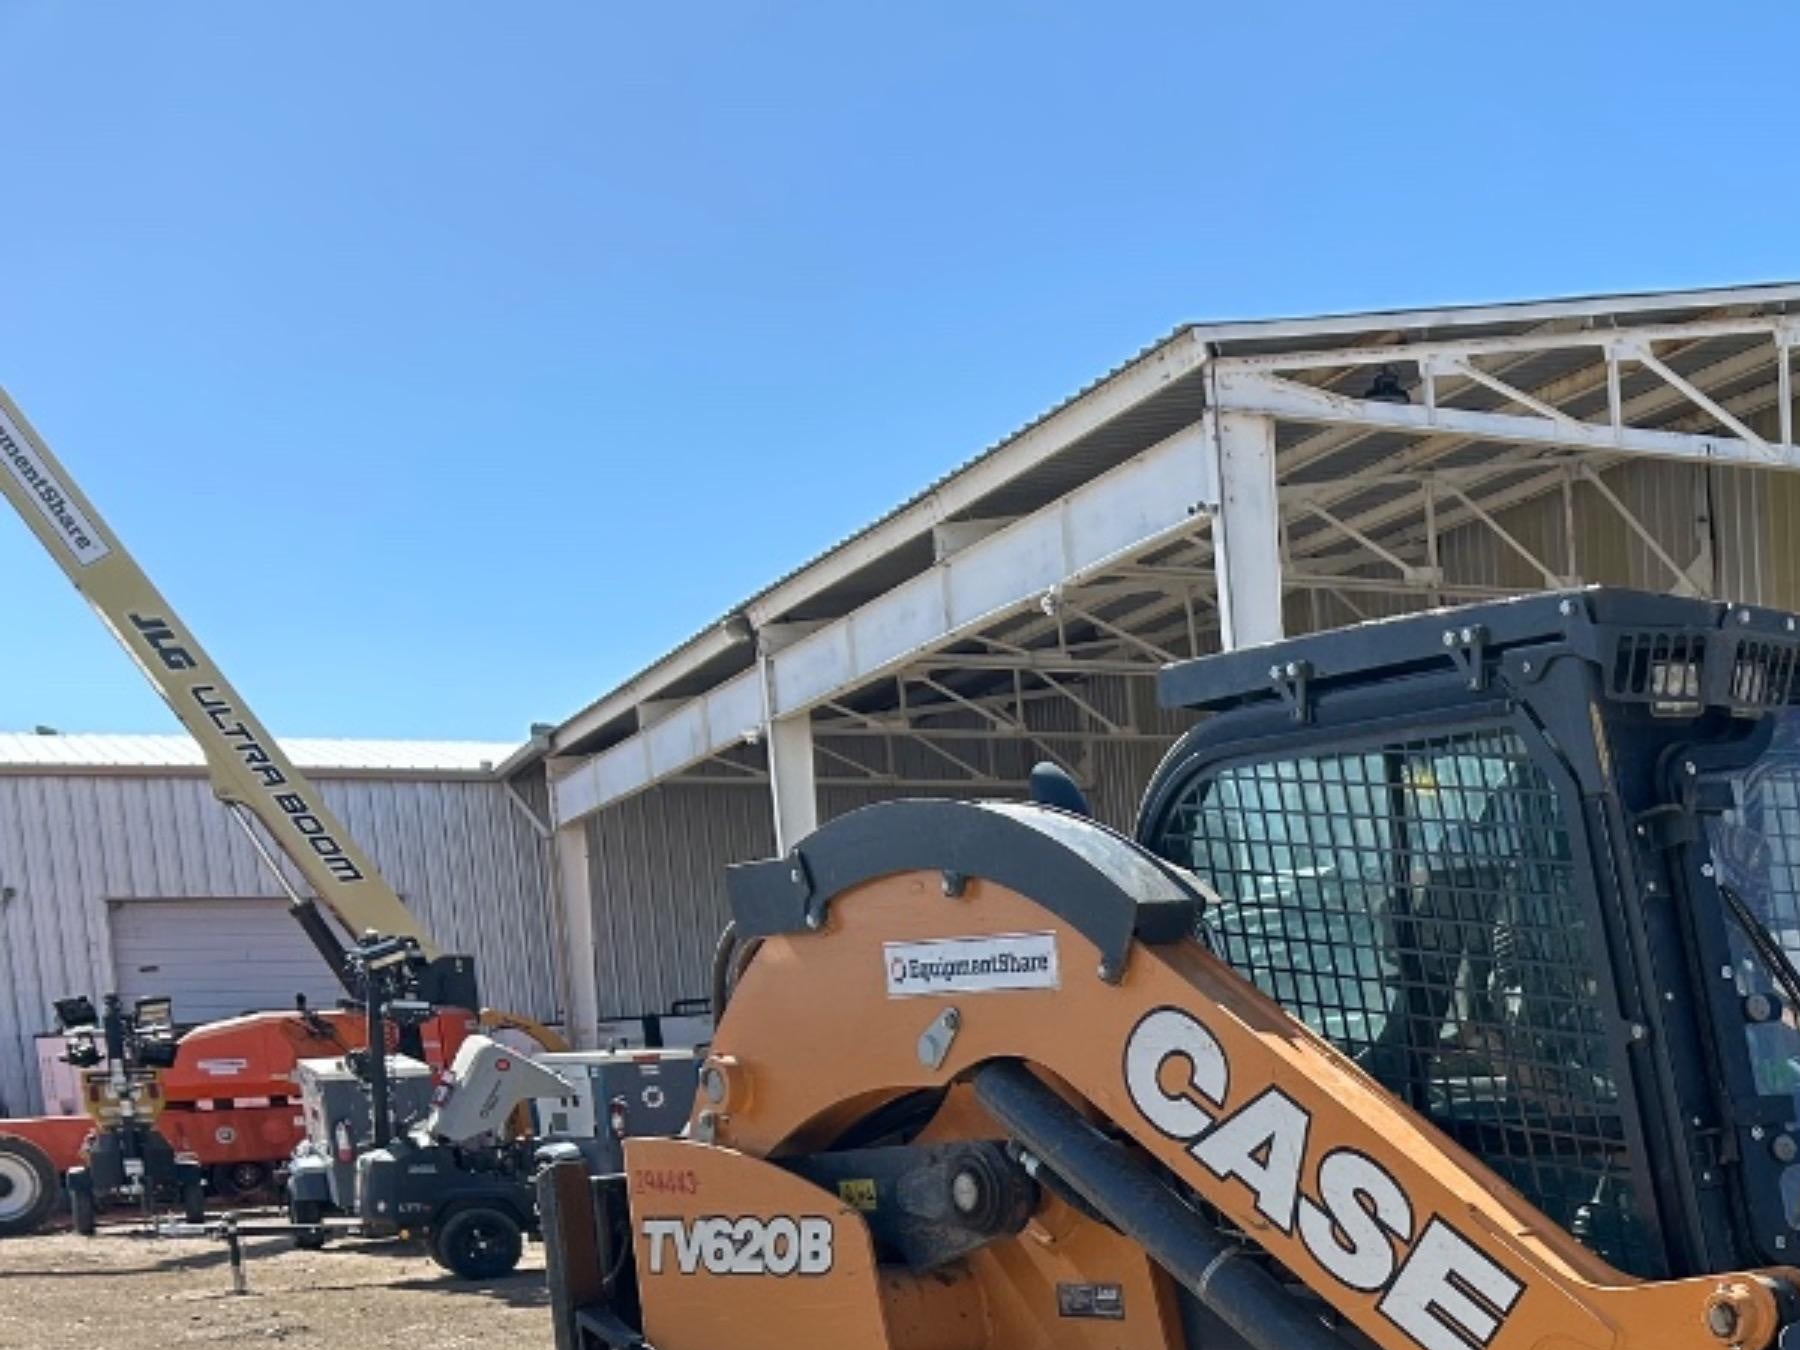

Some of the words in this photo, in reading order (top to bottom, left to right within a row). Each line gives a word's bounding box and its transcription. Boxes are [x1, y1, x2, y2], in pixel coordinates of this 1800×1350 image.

[128, 612, 198, 671] JLG
[190, 684, 287, 788] ULTRA
[273, 791, 365, 883] BOOM
[908, 951, 1049, 983] EquipmentShare
[641, 1214, 834, 1277] TV620B
